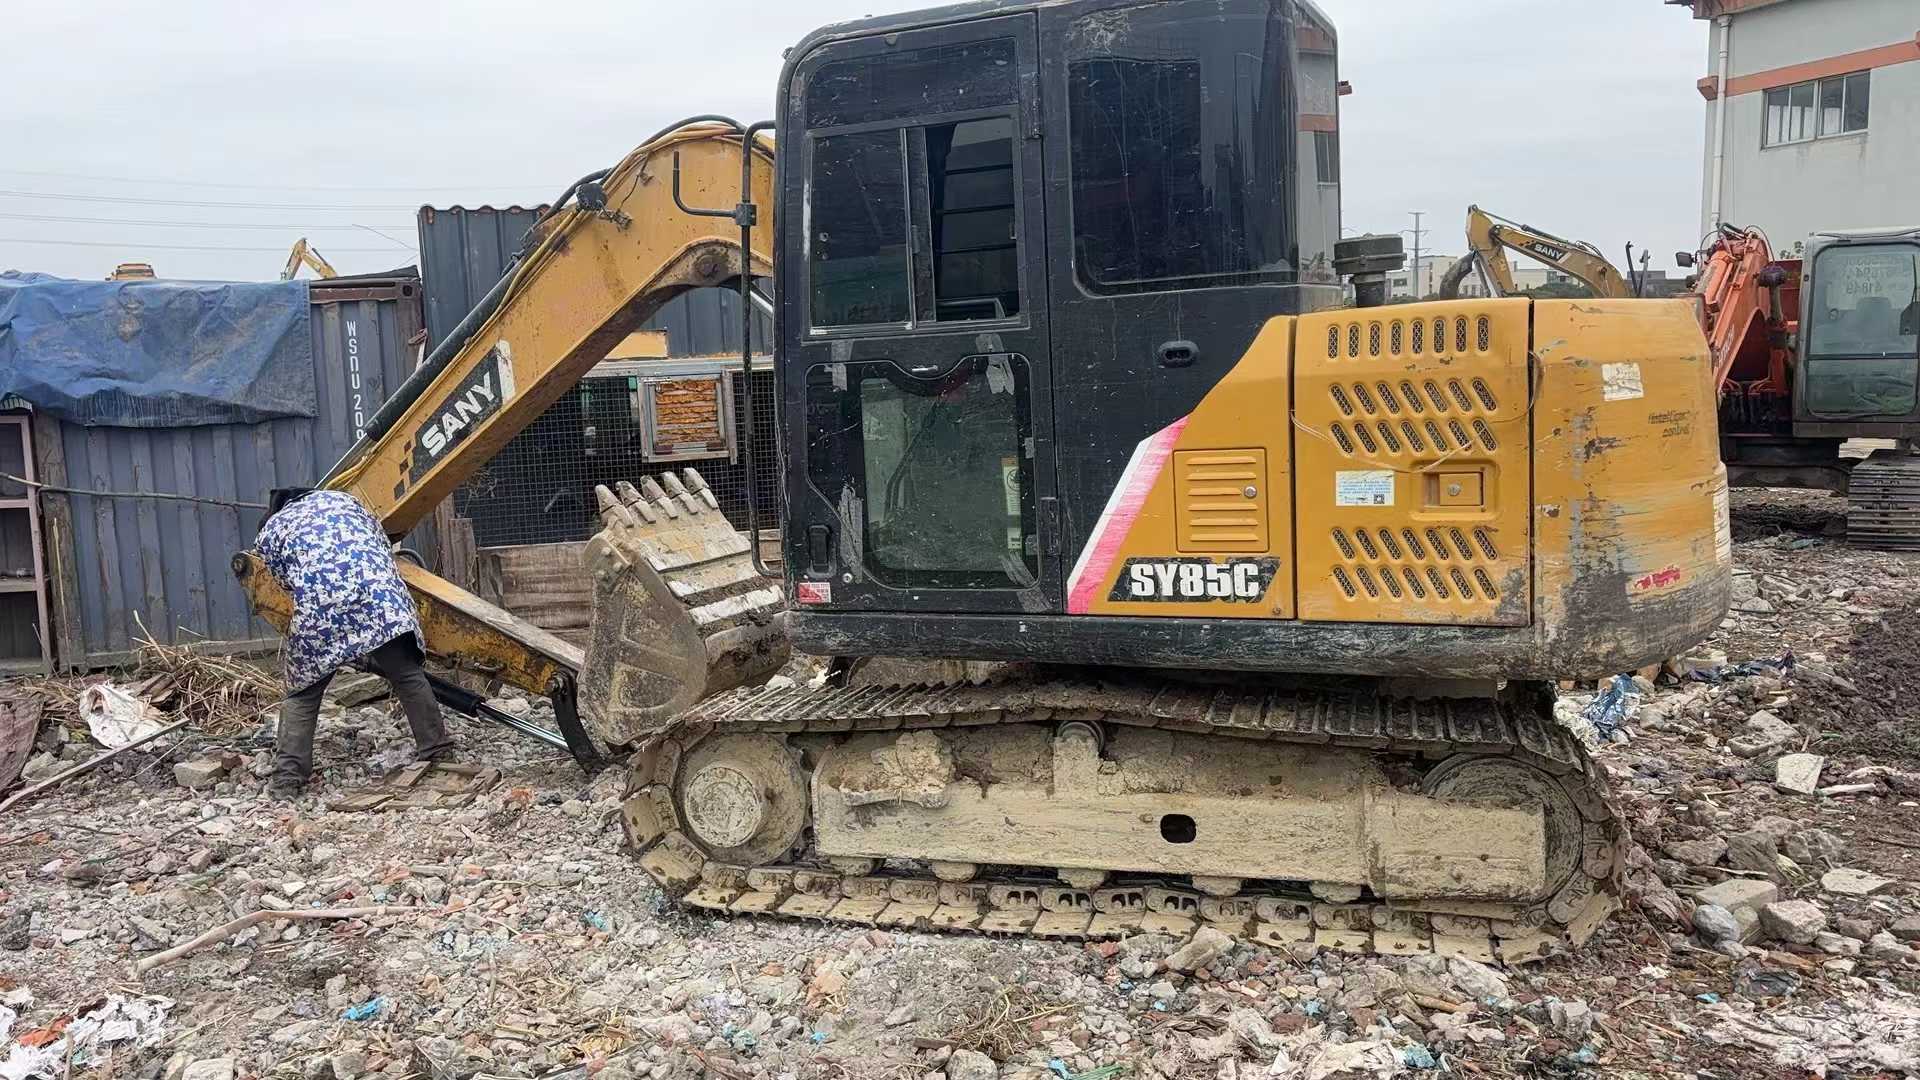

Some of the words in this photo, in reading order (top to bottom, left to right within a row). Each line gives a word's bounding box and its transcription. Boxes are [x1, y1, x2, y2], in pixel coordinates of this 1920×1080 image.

[1533, 243, 1563, 260] SANY
[420, 371, 495, 458] SANY
[1130, 563, 1260, 597] SY85C
